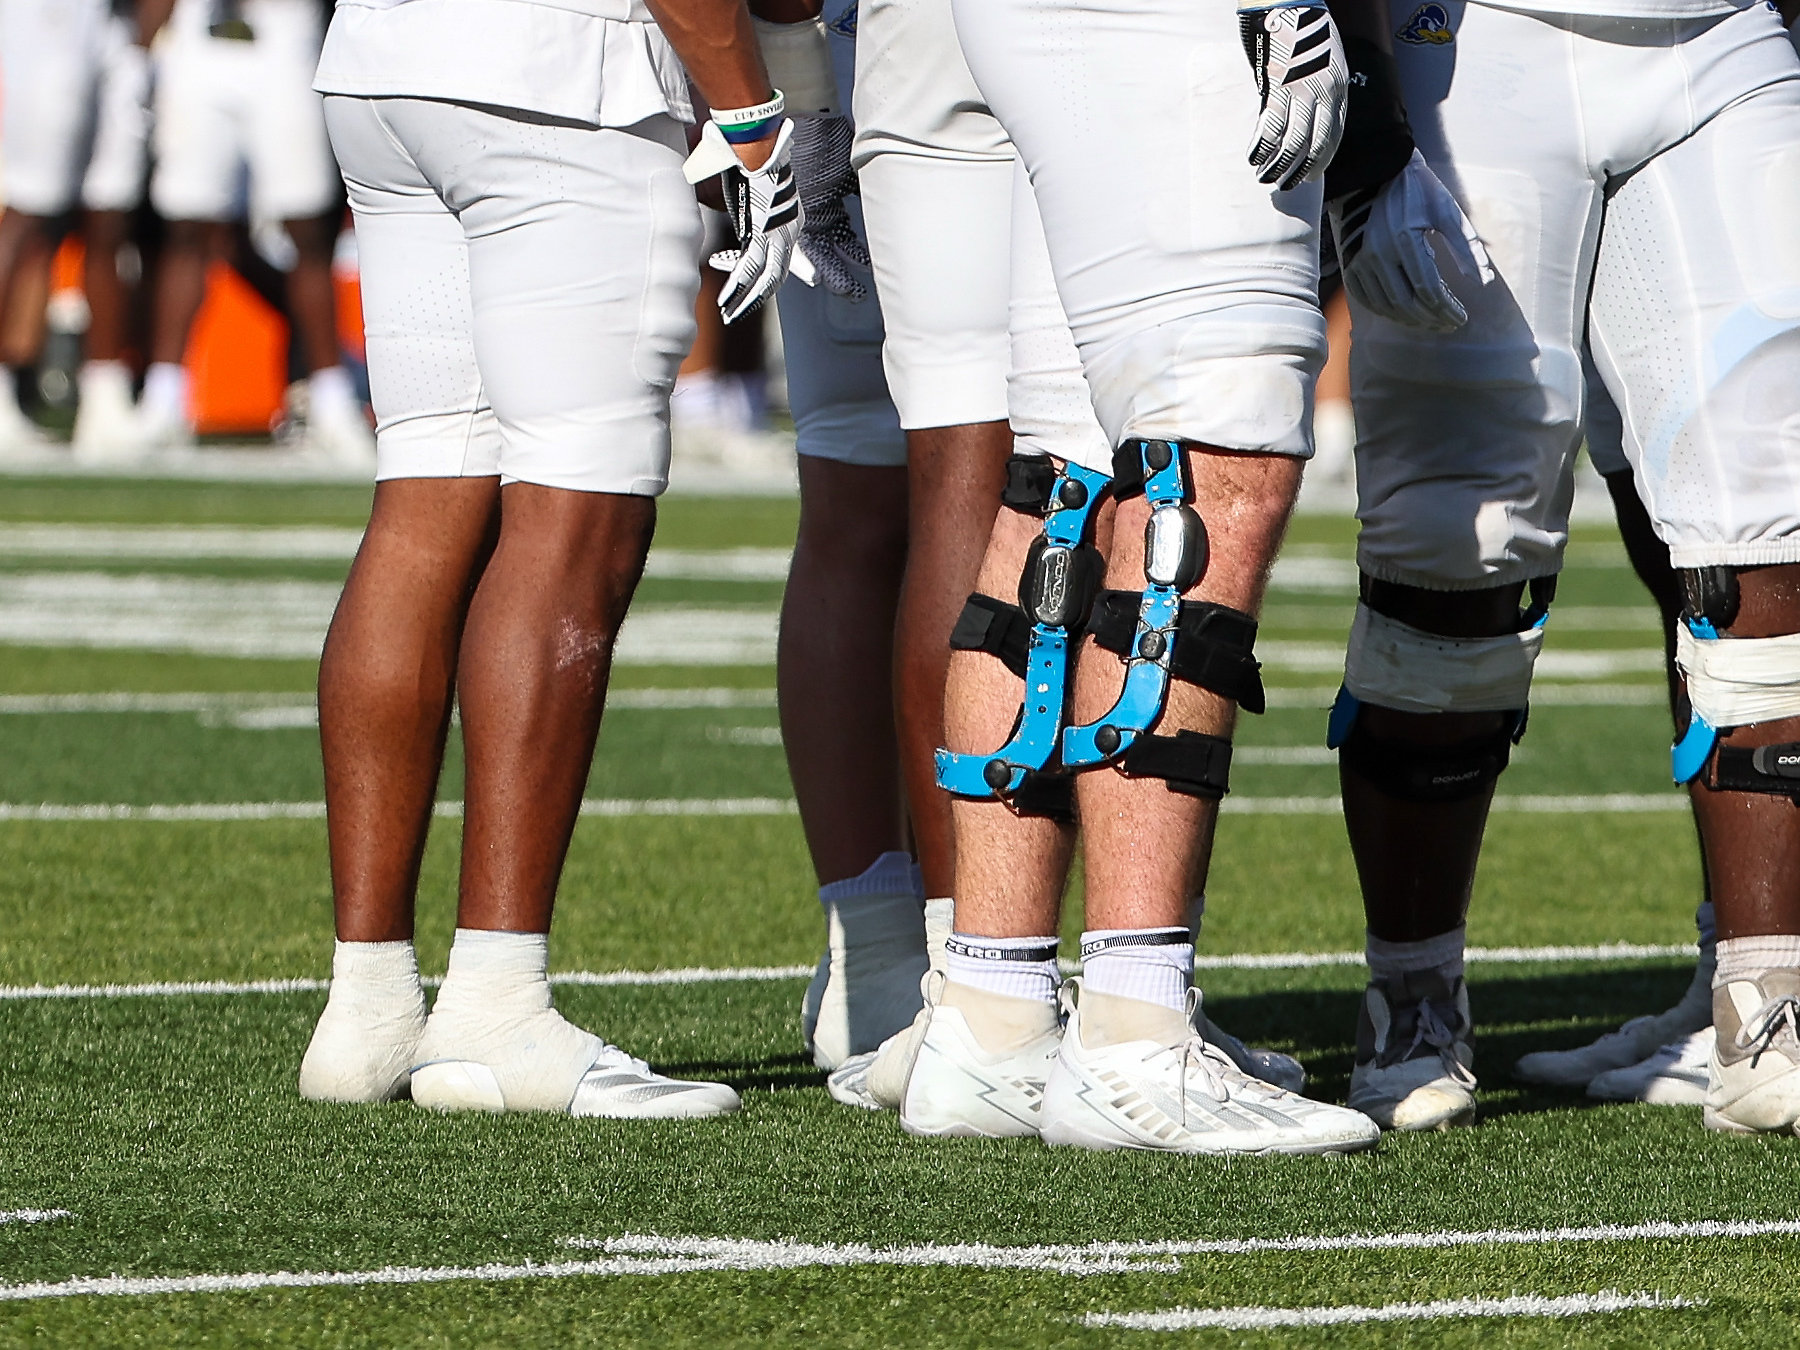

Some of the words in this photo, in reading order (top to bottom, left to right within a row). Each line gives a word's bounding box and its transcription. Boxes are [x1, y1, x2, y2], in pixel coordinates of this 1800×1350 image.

[1255, 33, 1264, 66] ELECTRIC
[734, 110, 755, 122] 4:13
[738, 182, 746, 214] ELECTRIC
[1432, 769, 1480, 783] DONJOY
